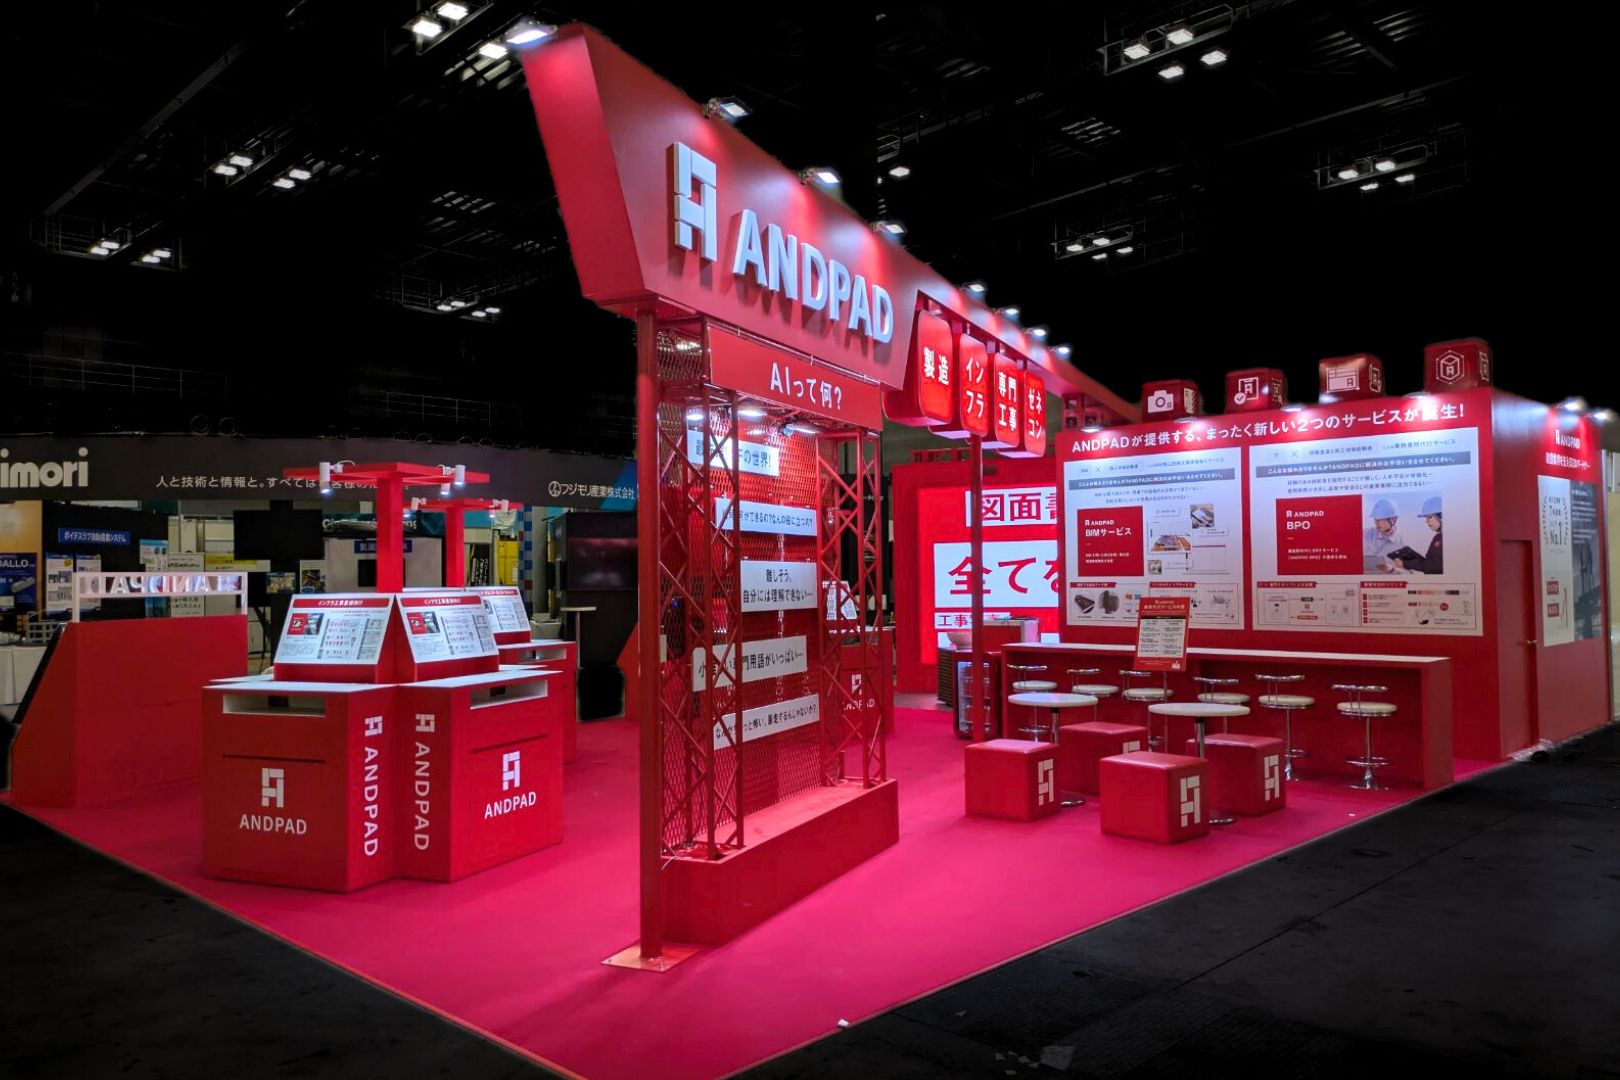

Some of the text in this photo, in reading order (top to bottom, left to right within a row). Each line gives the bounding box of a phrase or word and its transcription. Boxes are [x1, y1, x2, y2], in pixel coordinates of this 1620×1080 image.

[732, 209, 894, 344] ANDPAD
[923, 347, 949, 385] 製造
[966, 357, 984, 383] イン
[770, 362, 842, 410] AIって何?
[998, 372, 1017, 403] 専門
[966, 390, 984, 419] フラ
[999, 403, 1017, 431] 工事
[1028, 419, 1042, 439] コン
[1086, 527, 1132, 537] BIMサービス
[1287, 521, 1311, 530] BPO
[364, 747, 379, 856] ANDPAD
[415, 742, 430, 850] ANDPAD
[484, 791, 537, 819] ANDPAD
[239, 814, 307, 835] ANDPAD
